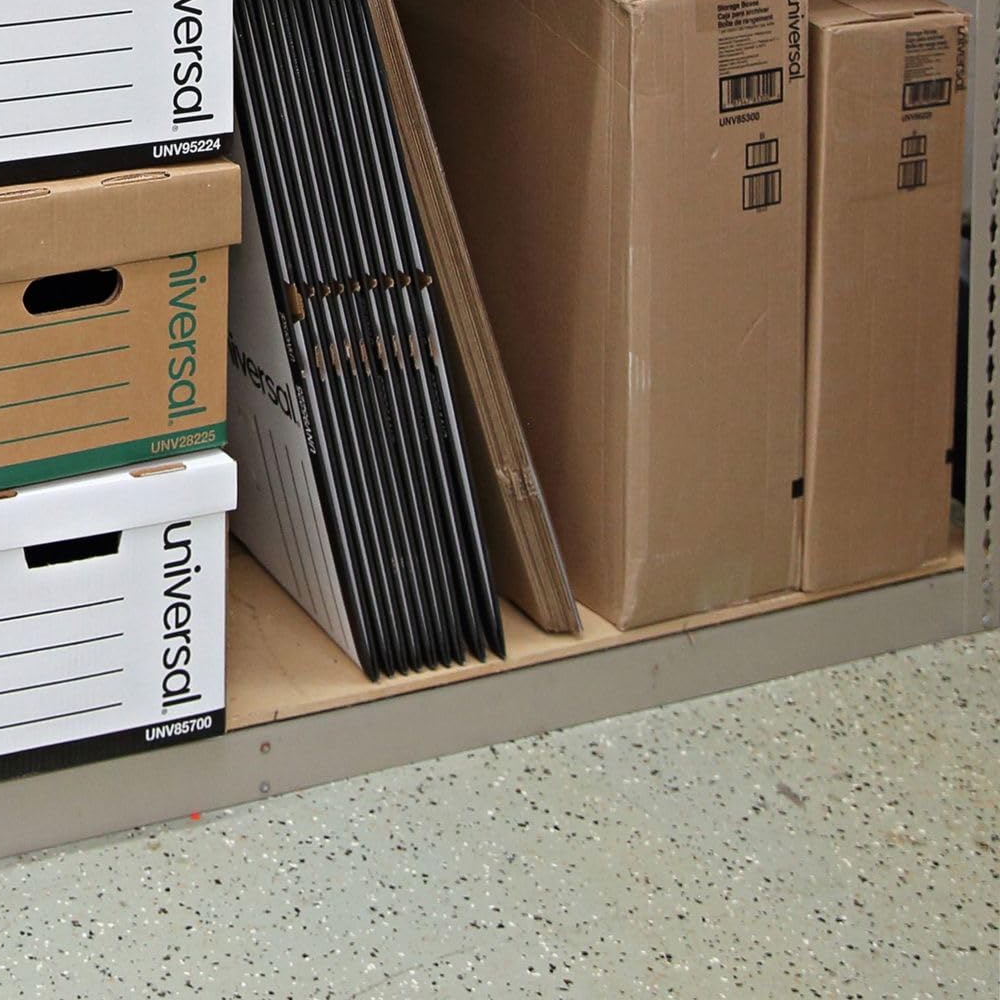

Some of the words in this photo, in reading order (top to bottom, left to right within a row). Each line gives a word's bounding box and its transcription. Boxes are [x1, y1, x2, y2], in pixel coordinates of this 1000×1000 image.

[152, 138, 221, 158] UNV95224
[168, 250, 207, 419] niversal
[229, 332, 298, 424] iversal
[149, 429, 216, 454] UNV28225
[162, 520, 202, 708] universal
[144, 715, 213, 742] UNV85700
